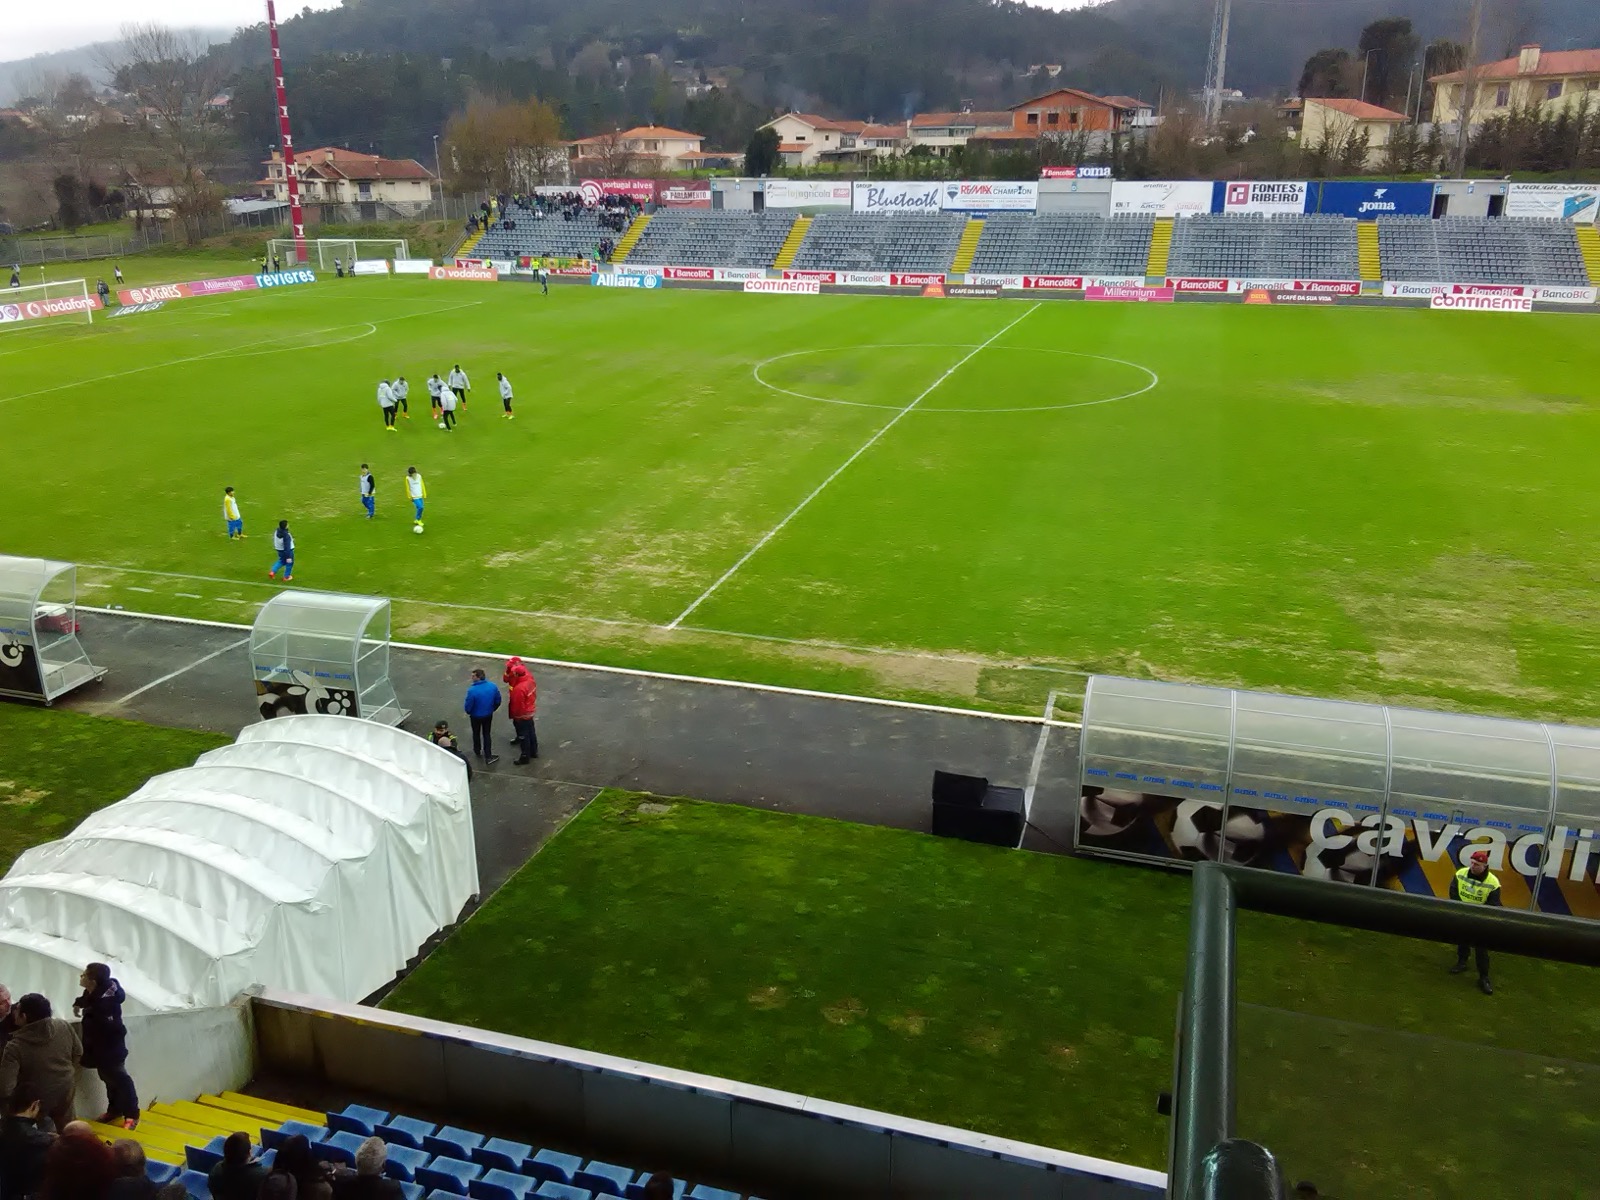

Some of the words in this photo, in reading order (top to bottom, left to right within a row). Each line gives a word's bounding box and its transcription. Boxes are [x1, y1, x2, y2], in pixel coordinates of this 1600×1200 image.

[602, 181, 630, 190] portugal
[633, 180, 652, 189] alves
[960, 184, 992, 195] RE/MAX
[1252, 183, 1297, 193] FONTES
[1297, 185, 1304, 193] &
[867, 187, 938, 208] Bluetooth
[1251, 193, 1299, 202] RIBEIRO
[448, 269, 492, 279] vodafone
[676, 269, 711, 279] BancoBIC
[727, 271, 762, 280] BancoBIC
[850, 274, 886, 283] BancoBIC
[203, 278, 244, 290] Millennium
[596, 274, 640, 288] Allianz
[904, 275, 942, 285] BancoBIC
[980, 277, 1018, 286] BancoBIC
[1038, 278, 1079, 287] BancoBIC
[1098, 279, 1139, 288] BancoBIC
[1181, 280, 1224, 290] BancoBIC
[745, 280, 819, 292] CONTINENTE
[1245, 282, 1289, 290] BancoBIC
[1311, 283, 1357, 293] BancoBIC
[1402, 285, 1448, 295] BancoBIC
[142, 284, 182, 302] SAGRES
[1104, 286, 1156, 297] Millennium
[1471, 287, 1520, 296] BancoBIC
[1541, 289, 1590, 300] BancoBIC
[42, 297, 97, 313] vodafone
[1432, 295, 1531, 310] CONTINENTE
